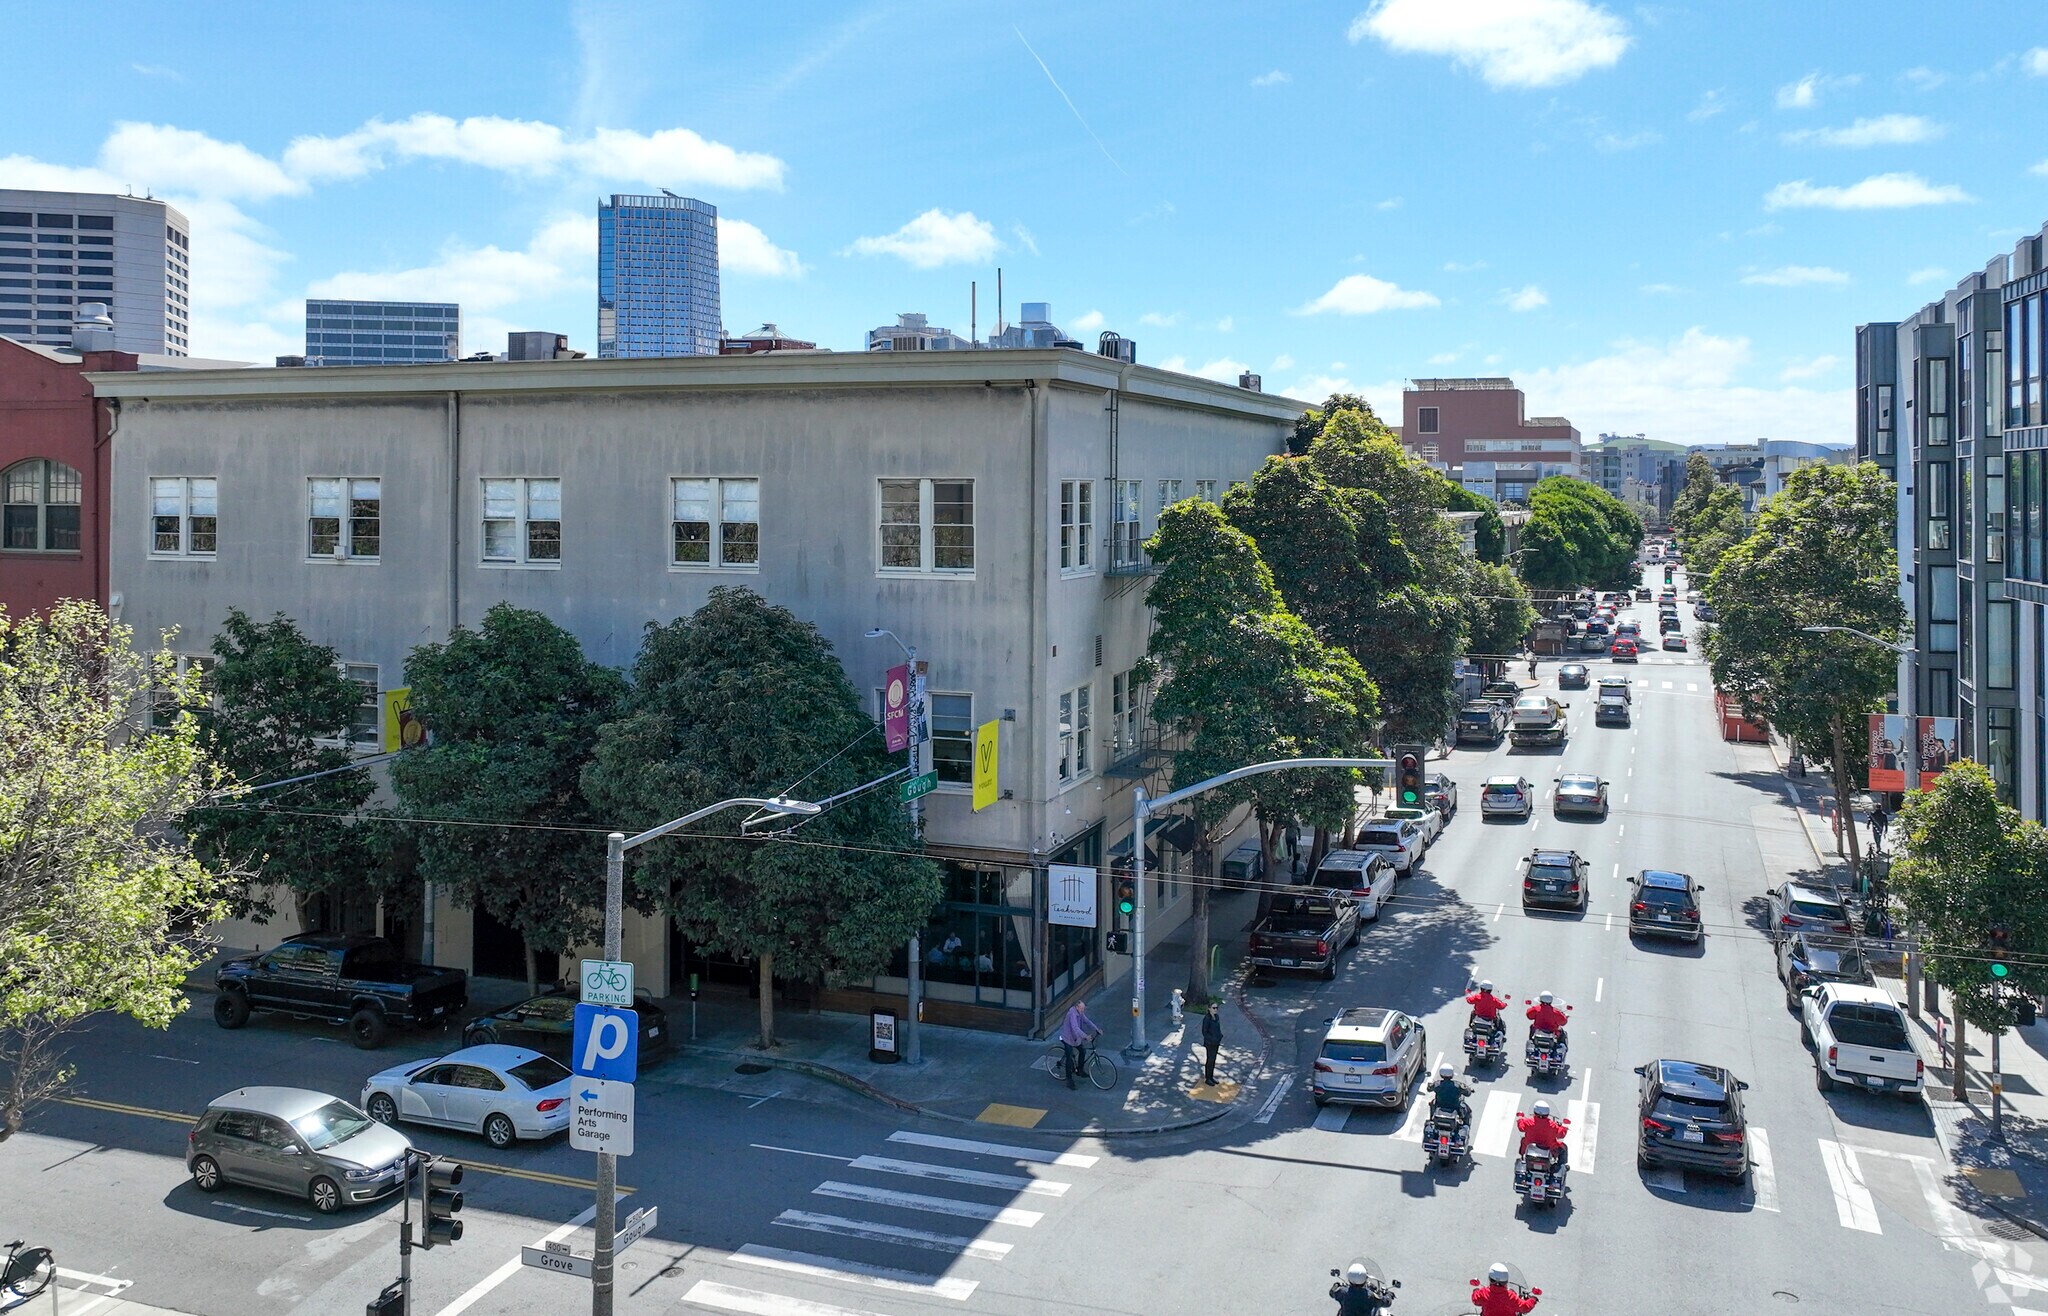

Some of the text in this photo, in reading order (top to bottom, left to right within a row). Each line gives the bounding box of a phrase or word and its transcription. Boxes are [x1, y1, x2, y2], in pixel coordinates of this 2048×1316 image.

[887, 710, 904, 720] SFCM
[907, 779, 932, 796] Gough
[1051, 903, 1093, 916] Teakwood
[587, 992, 626, 1003] PARKING
[578, 1105, 628, 1123] Performing
[577, 1117, 597, 1128] Arts
[577, 1127, 610, 1142] Garage
[623, 1222, 646, 1245] Gough
[540, 1254, 573, 1271] Grove
